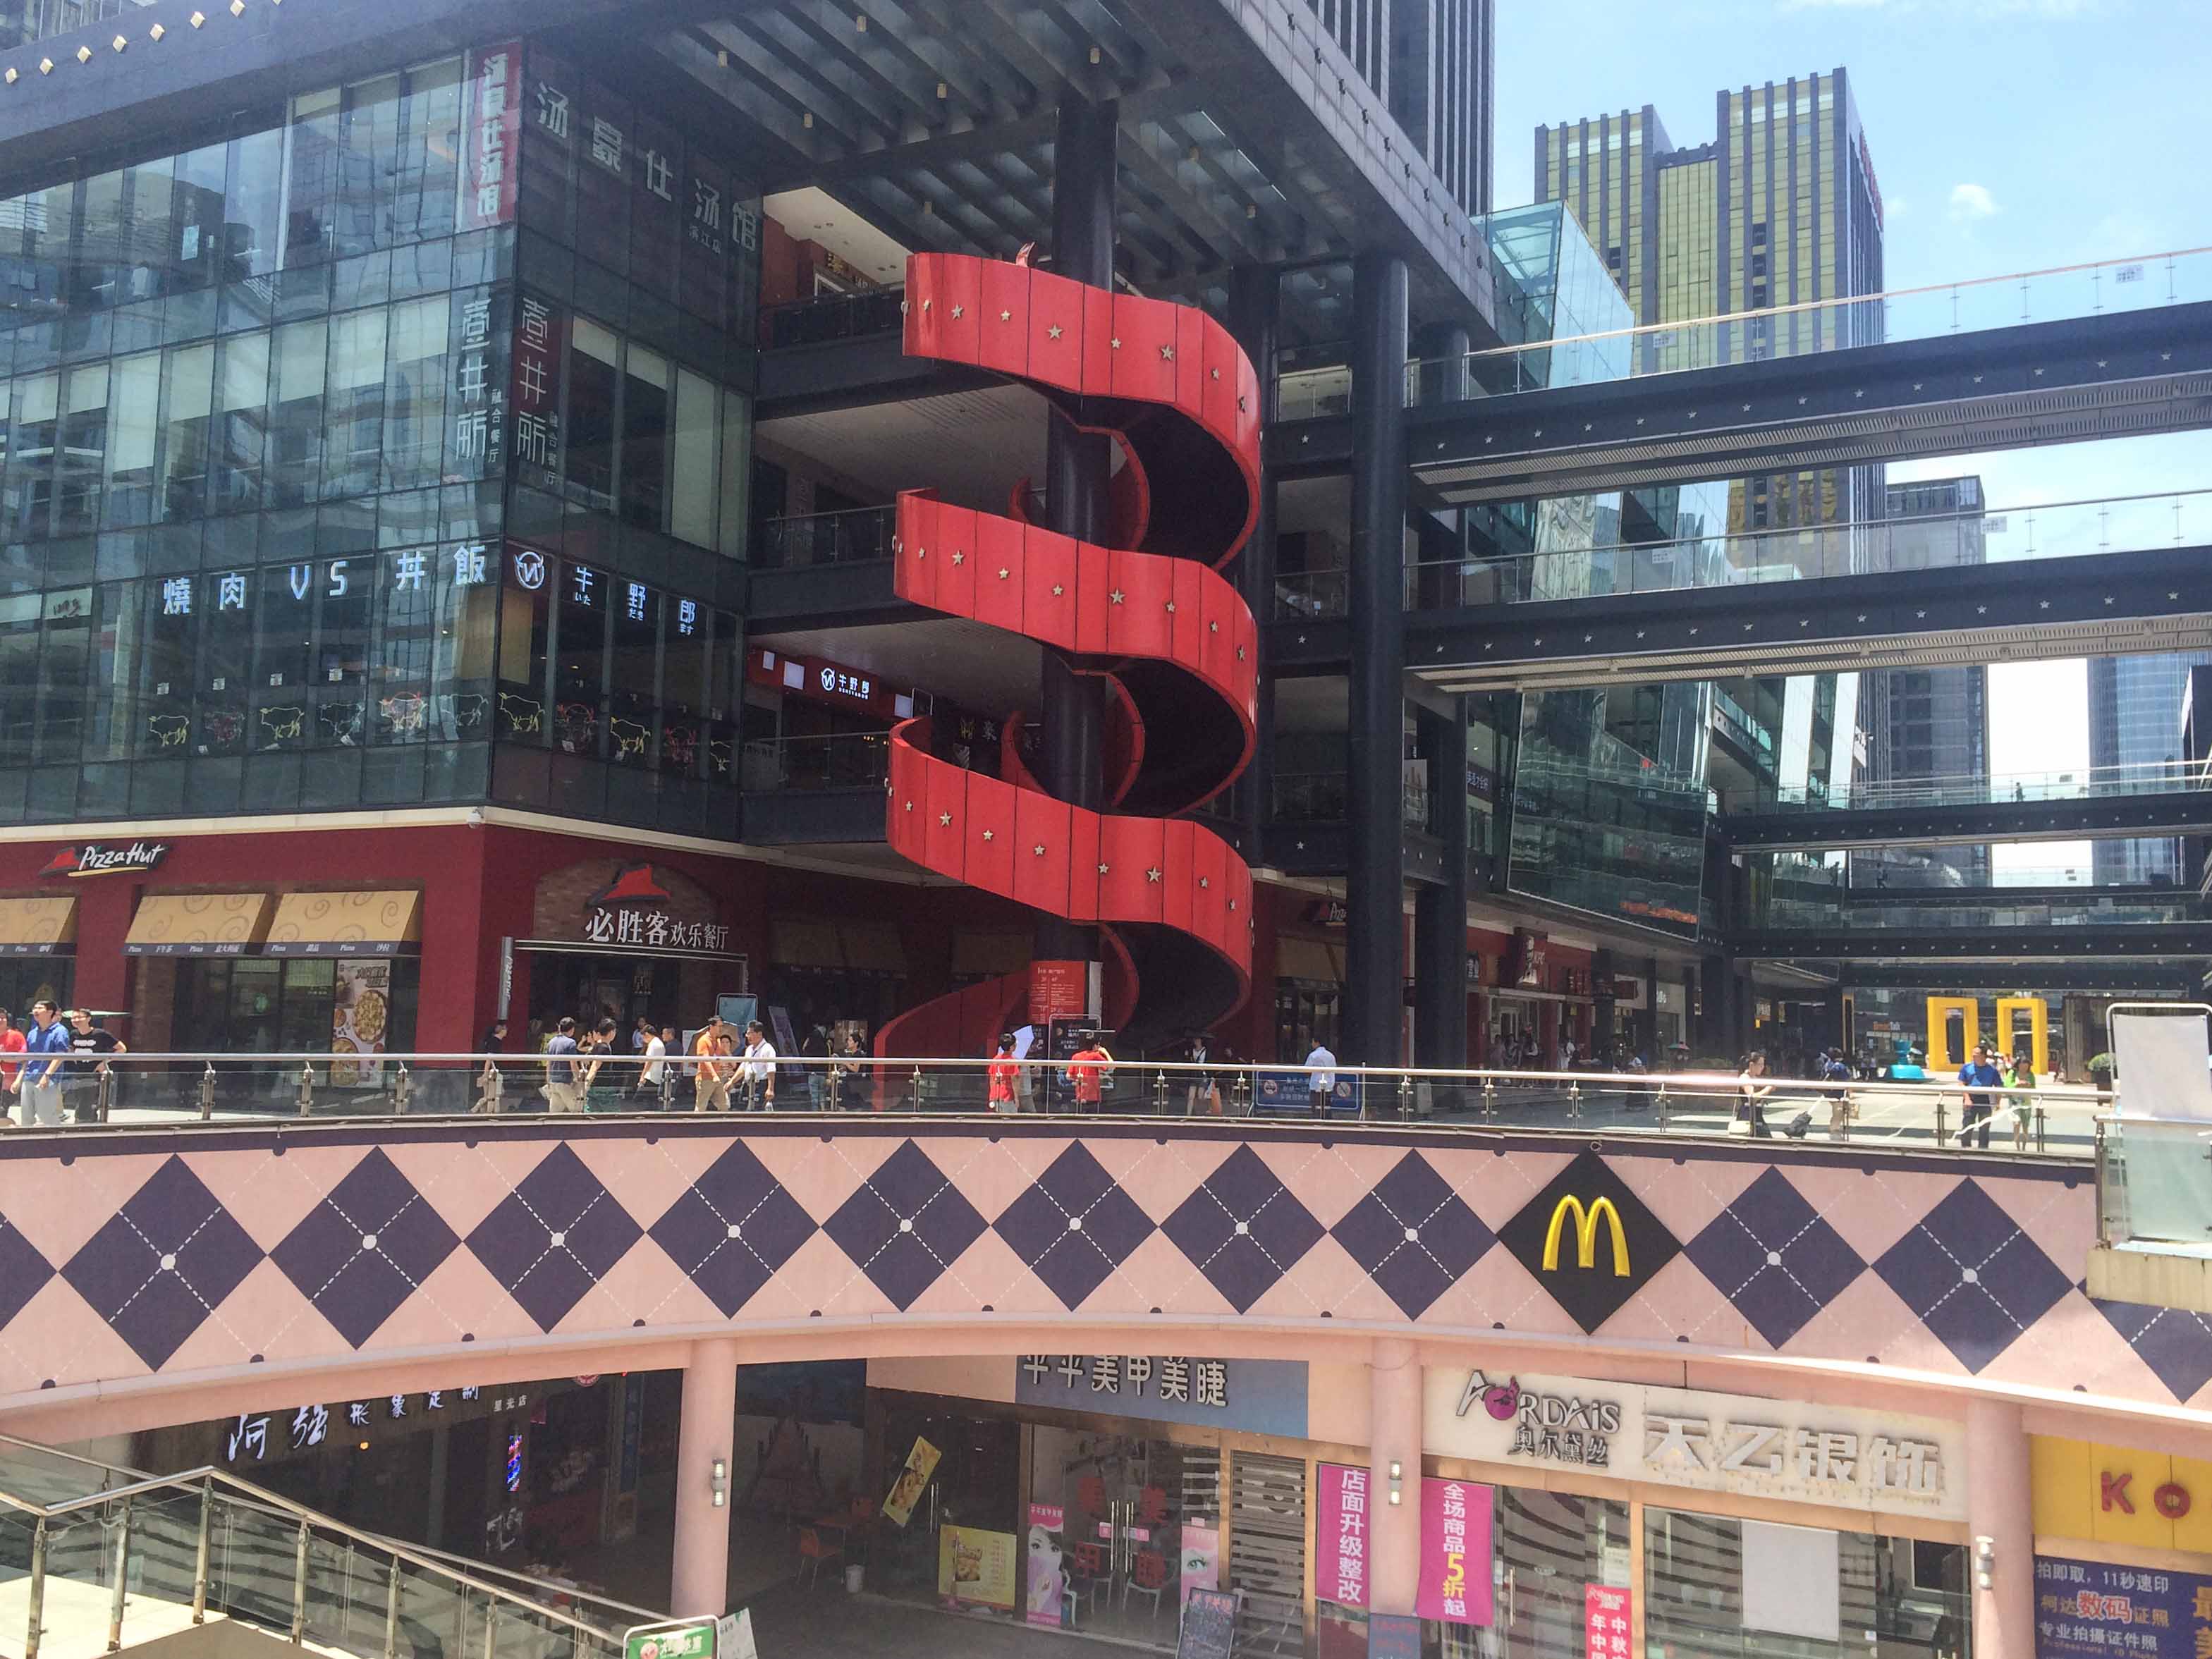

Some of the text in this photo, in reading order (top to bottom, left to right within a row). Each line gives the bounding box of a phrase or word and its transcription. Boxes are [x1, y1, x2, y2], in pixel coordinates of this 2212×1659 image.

[537, 81, 756, 251] 汤豪仕汤馆
[291, 561, 348, 600] VS
[575, 565, 697, 624] 牛野郎
[79, 843, 164, 871] Pizza Hut
[585, 907, 728, 950] 必胜客 欢乐餐厅
[1023, 1354, 1226, 1407] 平平美甲美睫
[1508, 1424, 1608, 1467] 奥尔黛丝
[1644, 1414, 1941, 1496] 天乙银饰
[2101, 1471, 2212, 1519] KO
[1338, 1469, 1366, 1603] 店面升级整改
[1442, 1483, 1468, 1617] 全场商品5折起
[1611, 1617, 1627, 1659] 中秋
[2039, 1622, 2158, 1651] 专业拍摄证件照
